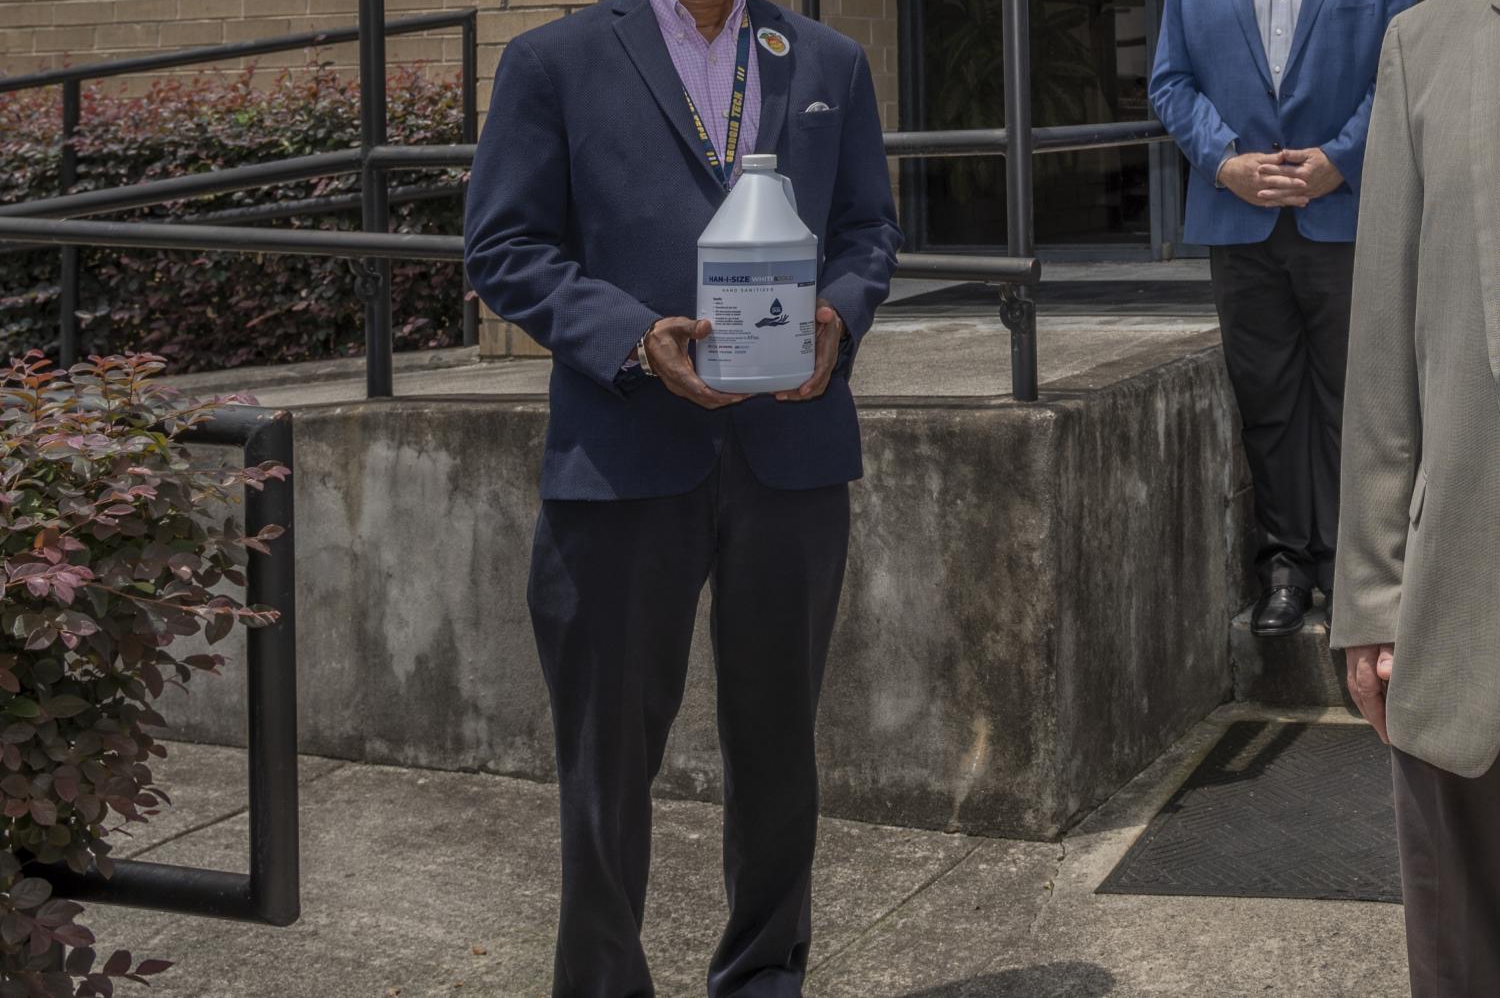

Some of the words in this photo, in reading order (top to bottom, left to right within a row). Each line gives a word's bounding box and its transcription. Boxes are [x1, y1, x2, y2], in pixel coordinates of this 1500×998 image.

[731, 90, 744, 118] TECH
[725, 119, 740, 163] GEORGIA
[708, 275, 751, 283] HAN-I-SIZE
